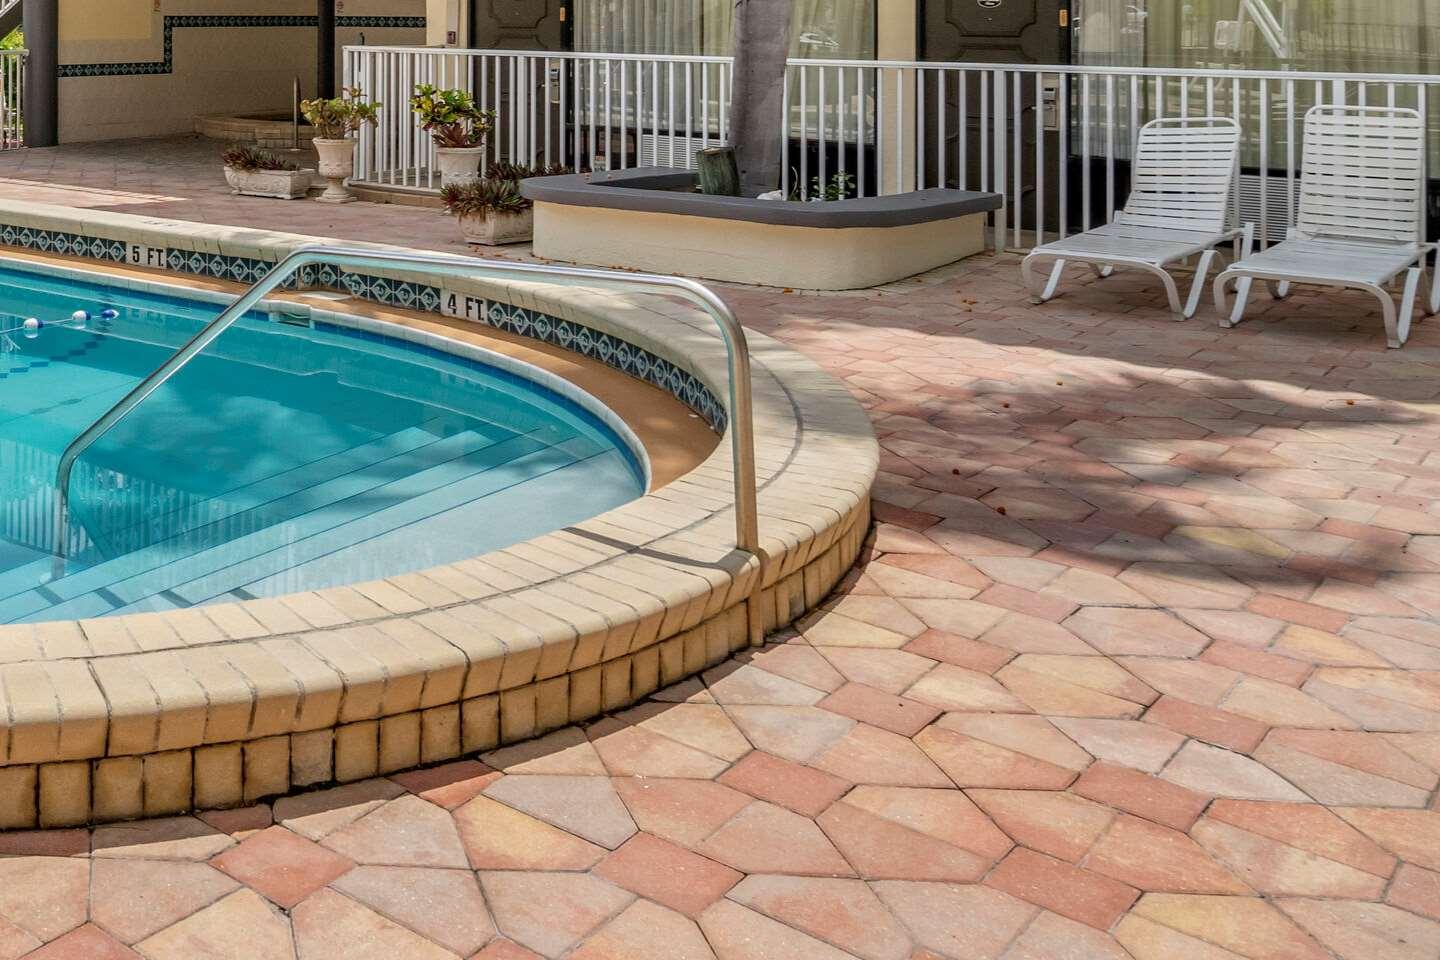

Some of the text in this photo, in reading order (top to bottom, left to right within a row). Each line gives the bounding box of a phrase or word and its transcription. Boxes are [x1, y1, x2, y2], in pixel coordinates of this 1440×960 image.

[132, 245, 164, 267] 5 FT.
[447, 293, 485, 321] 4 FT.
